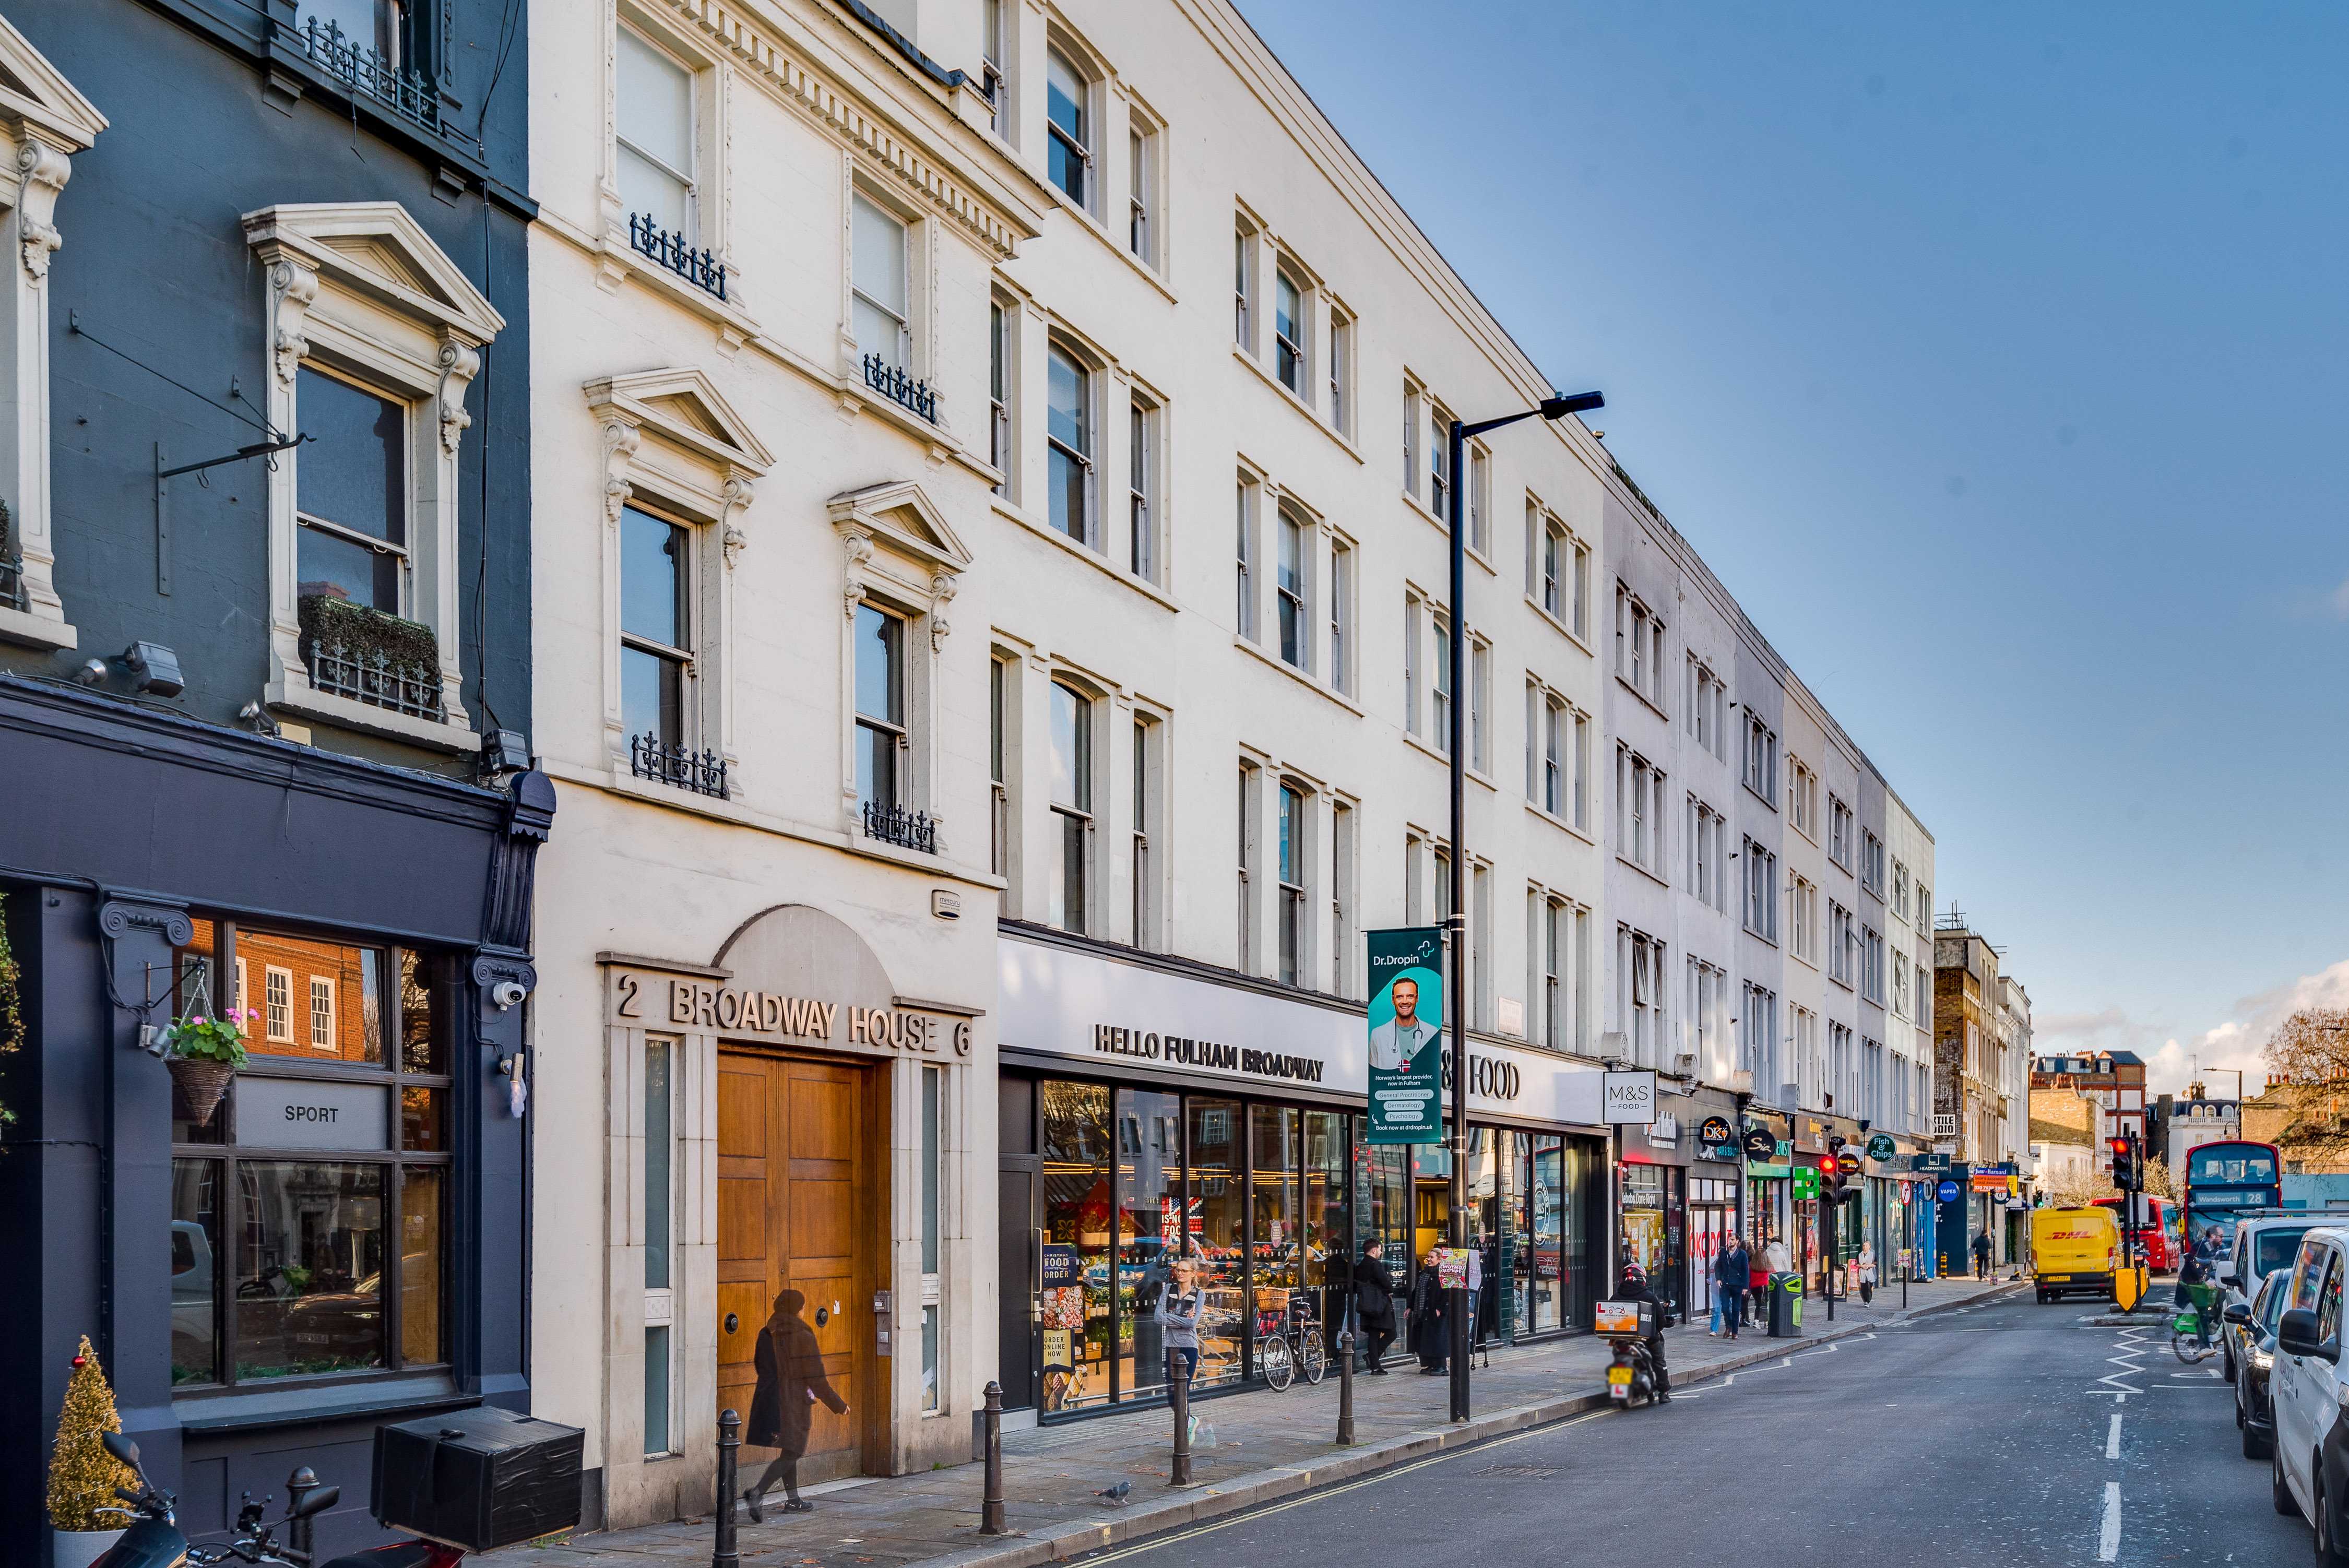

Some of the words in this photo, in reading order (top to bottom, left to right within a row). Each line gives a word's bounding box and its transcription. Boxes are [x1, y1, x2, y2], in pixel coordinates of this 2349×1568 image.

[940, 897, 960, 907] mercury
[1373, 954, 1419, 966] Dr.Dropin
[619, 974, 644, 1017] 2
[670, 980, 838, 1039] BROADWAY
[849, 1006, 940, 1052] HOUSE
[954, 1021, 973, 1056] 6
[1095, 1024, 1160, 1059] HELLO
[1165, 1035, 1238, 1070] FULHAM
[1241, 1048, 1324, 1082] BROADWAY
[1469, 1054, 1521, 1100] FOOD
[1610, 1085, 1648, 1101] M&S
[285, 1105, 339, 1123] SPORT
[1871, 1150, 1892, 1159] Chips
[2248, 1194, 2262, 1204] 28
[1161, 1214, 1170, 1224] IS
[1164, 1225, 1181, 1236] FOO
[2052, 1231, 2092, 1240] DHL
[1045, 1270, 1069, 1279] ORDER
[1597, 1303, 1606, 1313] L
[1615, 1385, 1623, 1395] L
